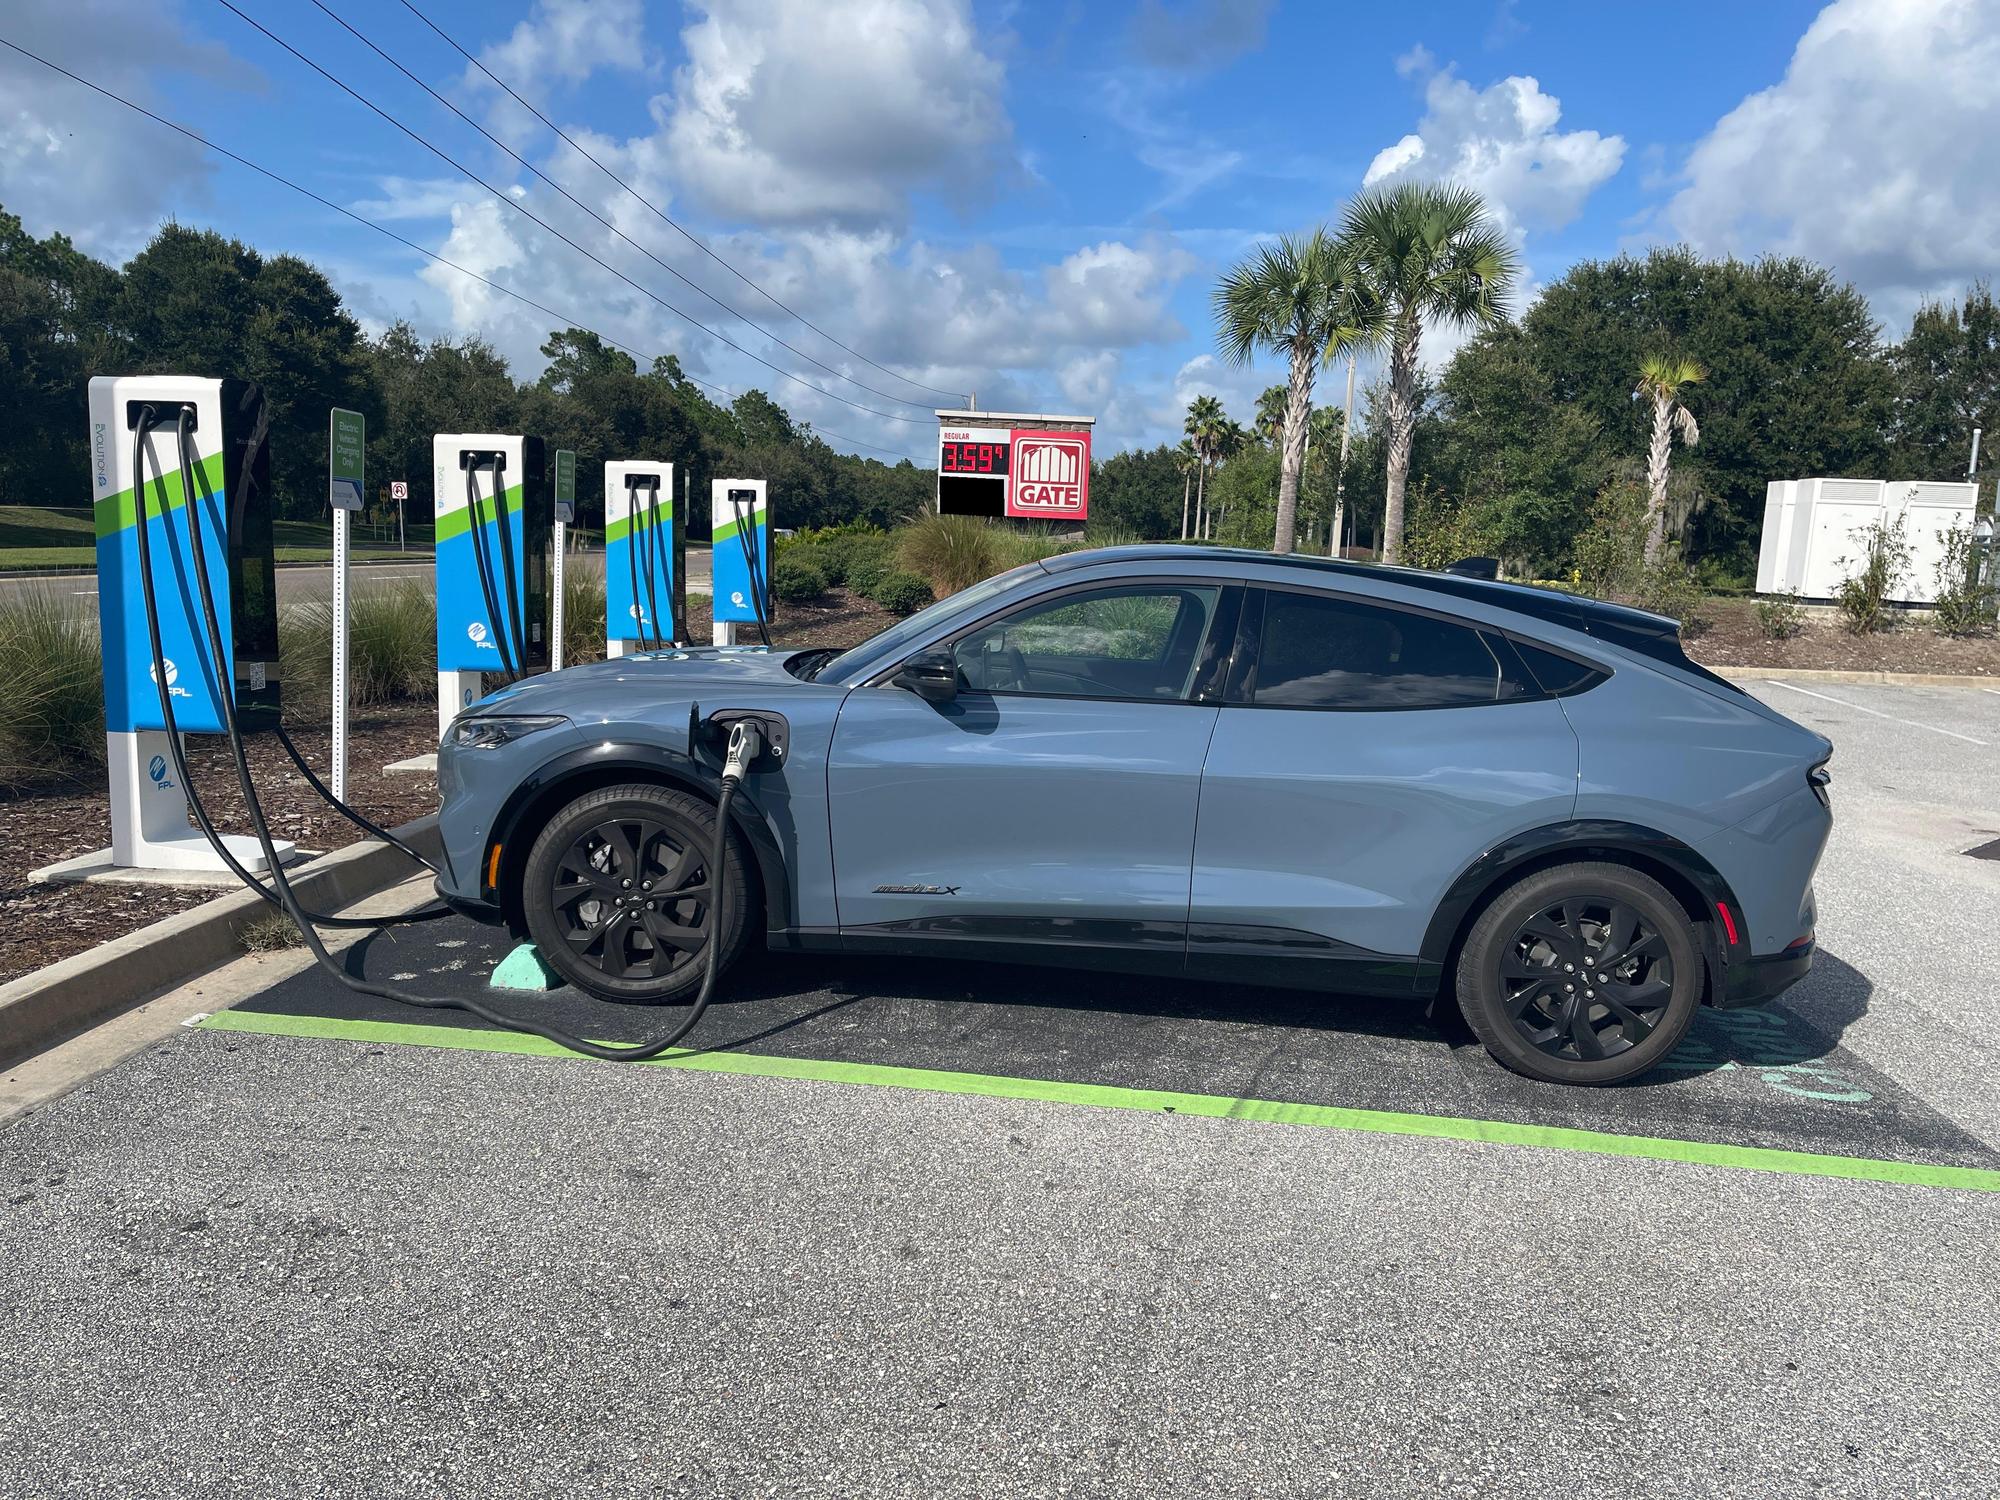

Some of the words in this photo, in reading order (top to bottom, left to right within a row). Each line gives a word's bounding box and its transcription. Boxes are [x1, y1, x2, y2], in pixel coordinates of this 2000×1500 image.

[944, 432, 970, 440] REGULAR
[336, 445, 360, 458] Charging
[342, 457, 354, 469] Only
[1019, 485, 1078, 506] GATE
[158, 780, 176, 792] FPL
